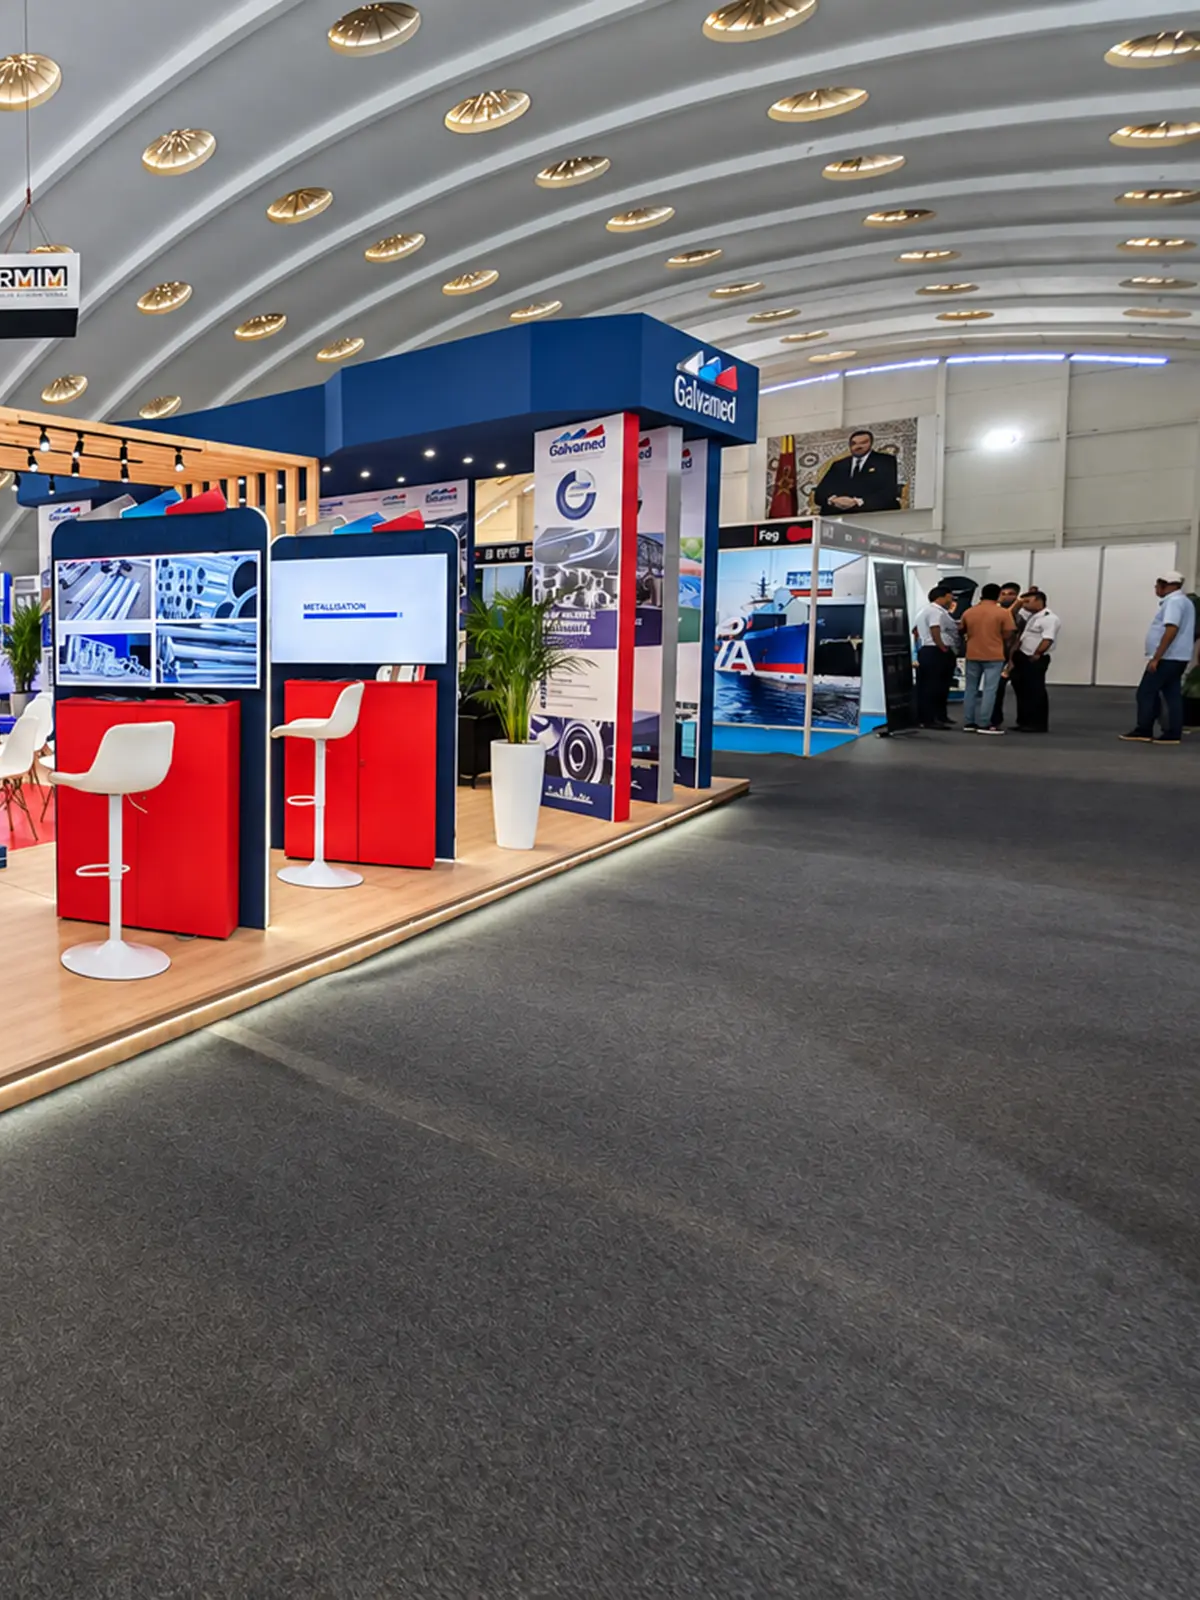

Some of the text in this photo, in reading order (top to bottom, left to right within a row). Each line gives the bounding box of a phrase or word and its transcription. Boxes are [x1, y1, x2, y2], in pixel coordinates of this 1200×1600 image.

[674, 375, 737, 424] Galvamed
[549, 436, 606, 457] Galvamed
[303, 603, 367, 611] METALLISATION
